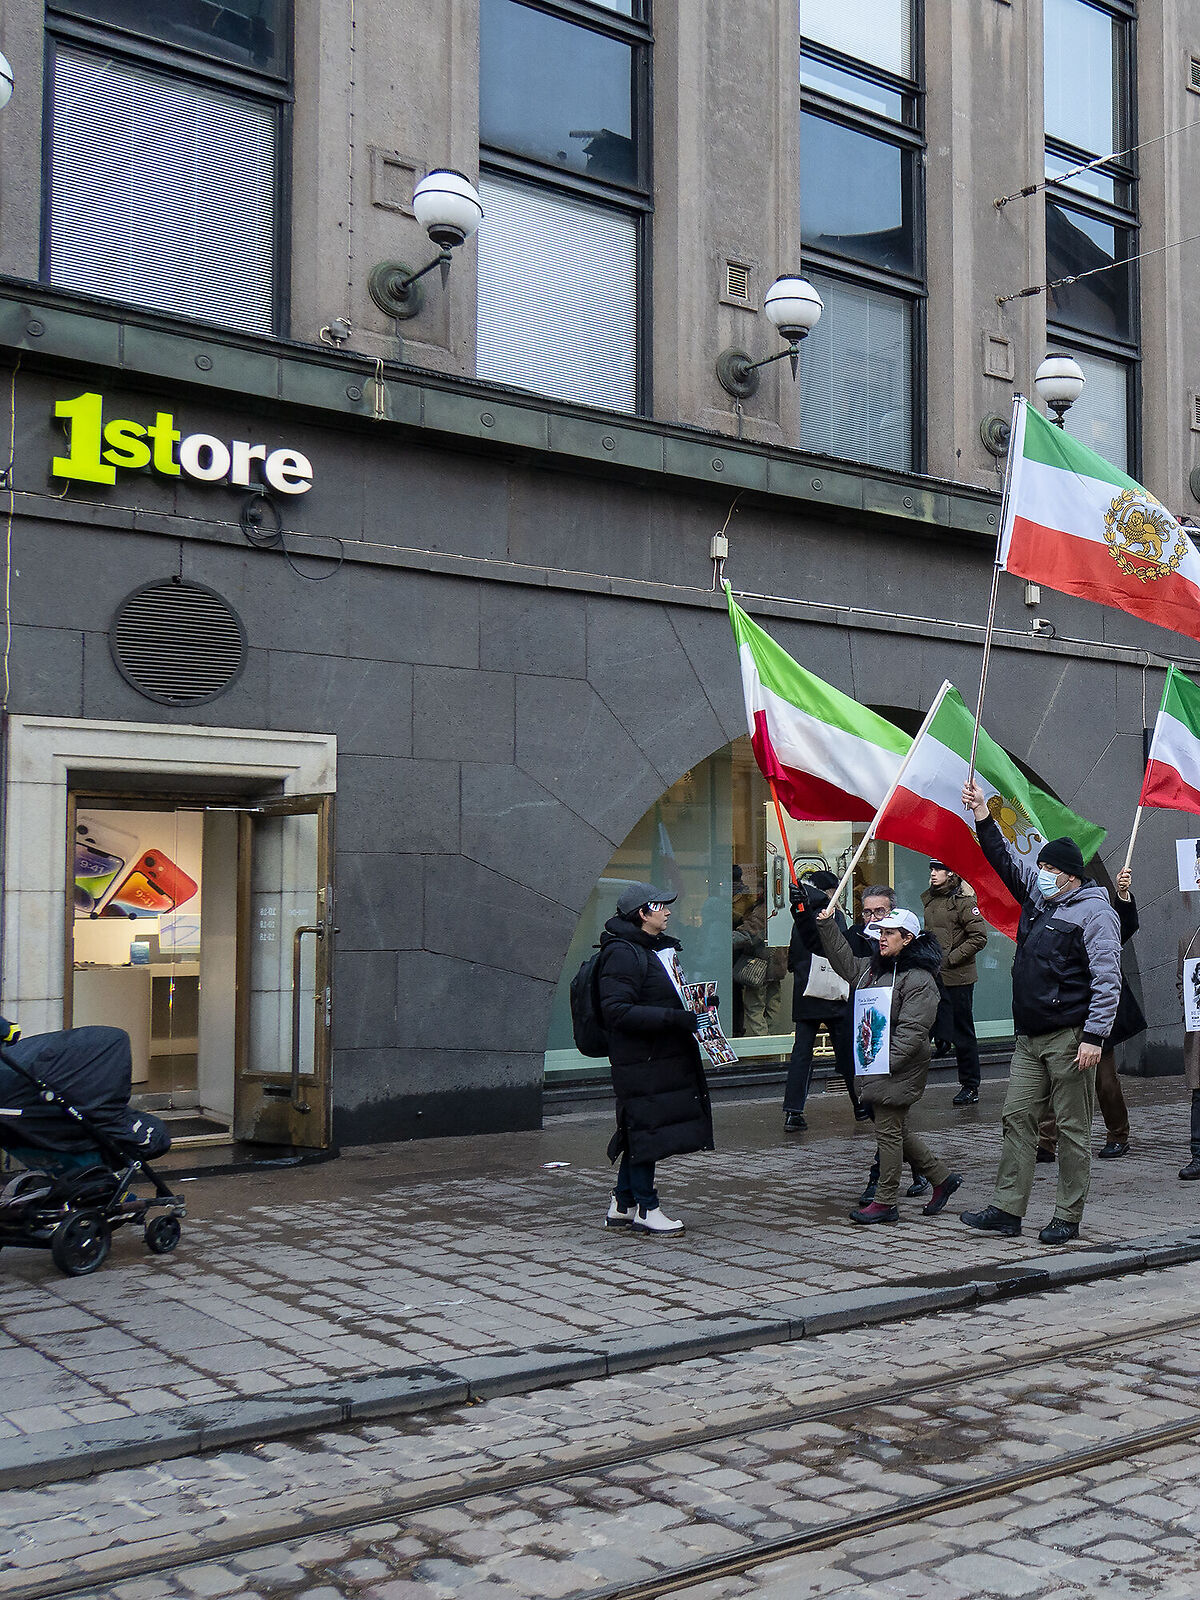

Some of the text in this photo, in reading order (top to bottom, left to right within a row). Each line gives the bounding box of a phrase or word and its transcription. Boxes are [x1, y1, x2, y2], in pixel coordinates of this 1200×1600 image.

[53, 392, 314, 495] 1store
[79, 859, 105, 874] 9:41
[135, 889, 155, 907] 9:41
